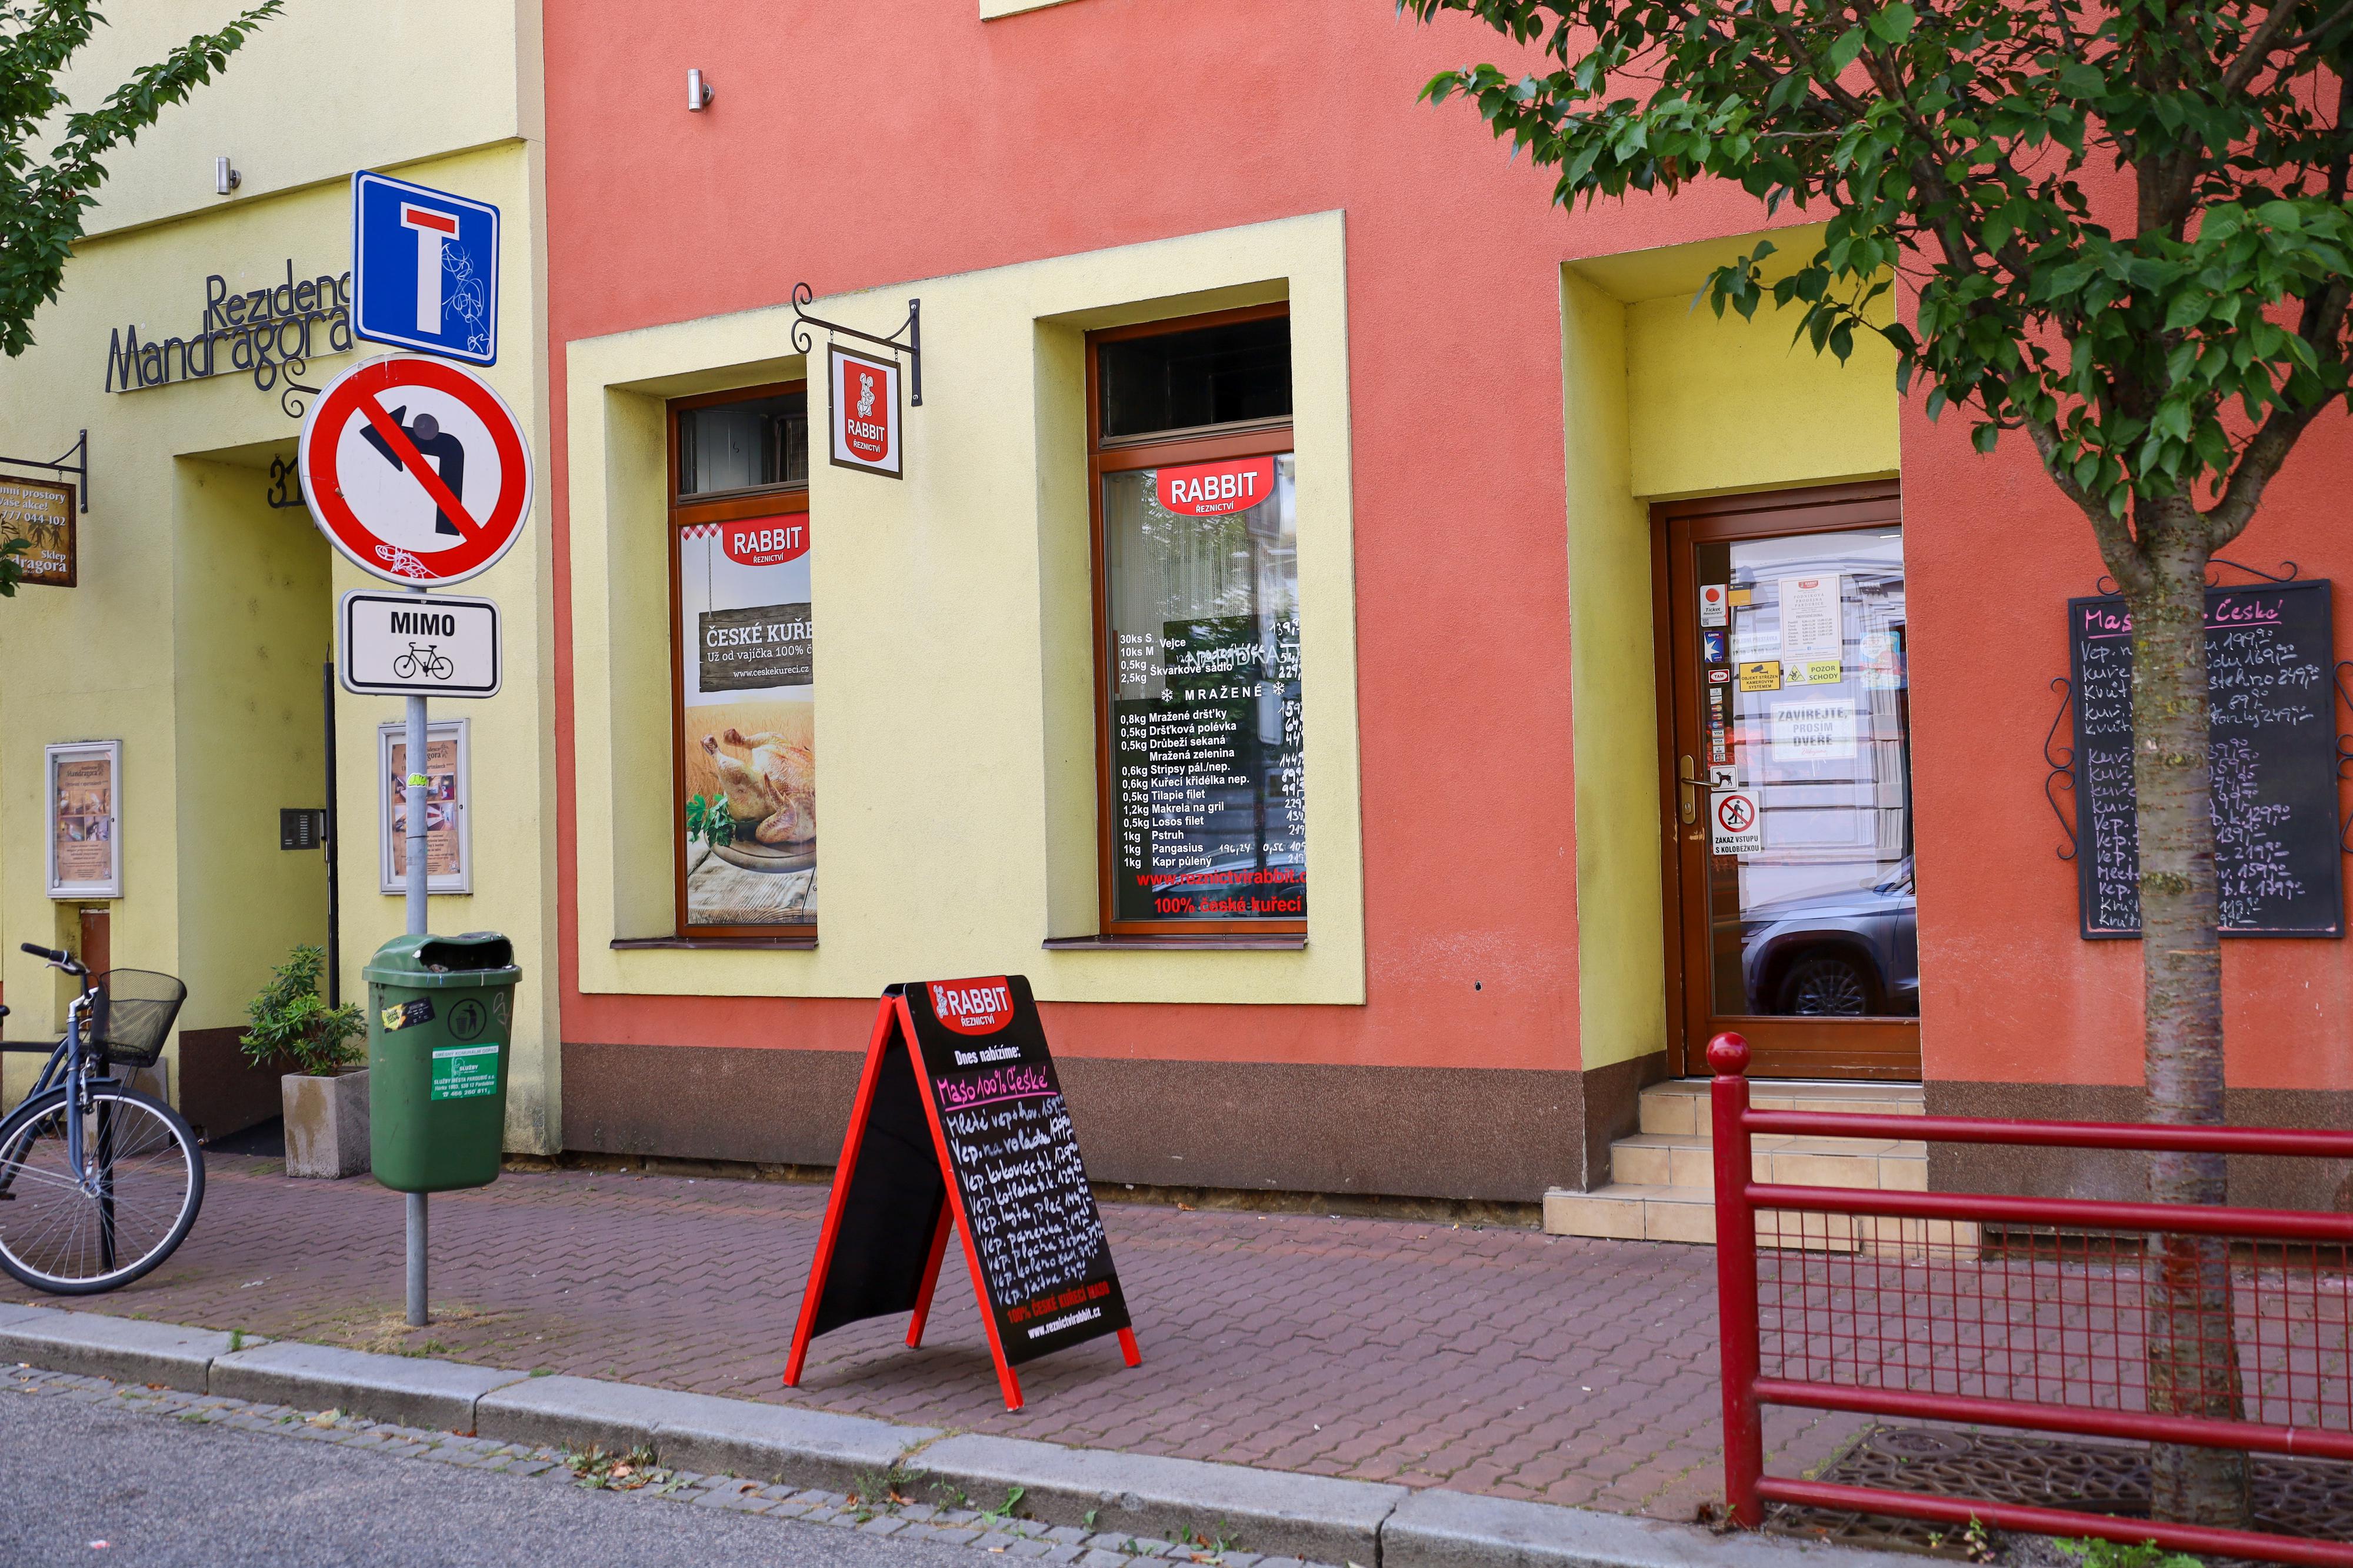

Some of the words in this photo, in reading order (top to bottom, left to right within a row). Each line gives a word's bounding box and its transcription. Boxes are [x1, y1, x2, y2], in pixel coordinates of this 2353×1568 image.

[105, 305, 353, 392] Mandragora
[848, 418, 885, 442] RABBIT
[853, 439, 881, 453] ŘEZNICTVÍ
[1171, 471, 1258, 504] RABBIT
[23, 489, 65, 504] prostory
[23, 499, 48, 511] akce!
[1195, 501, 1234, 513] ŘEZNICTVÍ
[2, 509, 21, 521] 777
[25, 512, 44, 523] 044
[49, 515, 66, 526] 102
[734, 526, 802, 555] RABBIT
[42, 551, 66, 562] Sklep
[753, 552, 784, 563] ŘEZNICTVÍ
[11, 555, 66, 574] dragora
[391, 612, 455, 636] MIMO
[2085, 609, 2132, 631] Mas
[706, 622, 762, 647] ČESKÉ
[1120, 634, 1142, 644] 30ks
[1145, 633, 1152, 642] S
[1159, 638, 1186, 649] Vejce
[708, 652, 719, 662] Už
[722, 649, 735, 661] od
[736, 647, 773, 662] vajíčka
[775, 645, 804, 657] 100%
[1121, 647, 1142, 657] 10ks
[1146, 646, 1154, 656] M
[733, 665, 809, 678] www.ceskekureci.cz
[1121, 660, 1146, 671] 0,5kg
[1150, 663, 1201, 676] Škvarkové
[1205, 662, 1233, 673] sádlo
[1121, 673, 1146, 684] 2,5kg
[1185, 683, 1262, 700] MRAŽENÉ
[1121, 715, 1146, 725] 0,8kg
[1149, 710, 1190, 723] Mražené
[1778, 707, 1848, 722] ZAVÍREJTE,
[1121, 728, 1146, 738] 0,5kg
[1198, 721, 1237, 733] polévka
[1793, 720, 1833, 733] PROSÍM
[1121, 740, 1147, 751] 0,5kg
[1150, 736, 1187, 748] Drůbeží
[1190, 735, 1225, 746] sekaná
[1794, 733, 1833, 747] DVEŘE
[1149, 749, 1191, 762] Mražená
[1193, 748, 1234, 759] zelenina
[1122, 766, 1148, 777] 0,6kg
[1151, 764, 1185, 775] Stripsy
[1188, 762, 1231, 773] pál./nep.
[1122, 780, 1148, 790] 0,6kg
[1151, 776, 1183, 788] Kuřecí
[1186, 775, 1225, 786] křidélka
[1228, 775, 1249, 785] nep.
[1123, 792, 1149, 803] 0,5kg
[1151, 790, 1184, 802] Tilapie
[1187, 789, 1205, 799] filet
[1124, 805, 1149, 816] 1,2kg
[1152, 803, 1190, 814] Makrela
[1193, 803, 1205, 812] na
[1208, 802, 1224, 814] gril
[1124, 819, 1149, 829] 0,5kg
[1152, 816, 1182, 827] Losos
[1185, 816, 1204, 825] filet
[1123, 832, 1141, 842] 1kg
[1152, 830, 1184, 840] Pstruh
[1124, 845, 1141, 855] 1kg
[1152, 843, 1204, 855] Pangasius
[1721, 844, 1759, 853] KOLOBĚŽKOU
[1124, 858, 1141, 869] 1kg
[1152, 856, 1175, 868] Kapr
[1178, 855, 1212, 868] půlený
[1155, 898, 1195, 913] 100%
[1200, 897, 1246, 912] české
[1251, 896, 1301, 912] kuřecí
[946, 986, 1008, 1016] RABBIT
[961, 1013, 995, 1027] ŘEZNICTVÍ
[954, 1049, 978, 1066] Dnes
[980, 1045, 1021, 1062] nabízíme:
[1007, 1305, 1032, 1324] 100%
[1031, 1293, 1058, 1317] ČESKÉ
[1058, 1284, 1087, 1309] KUŘECÍ
[1086, 1280, 1110, 1299] MASO
[1028, 1306, 1101, 1339] www.reznictvirabbit.cz
